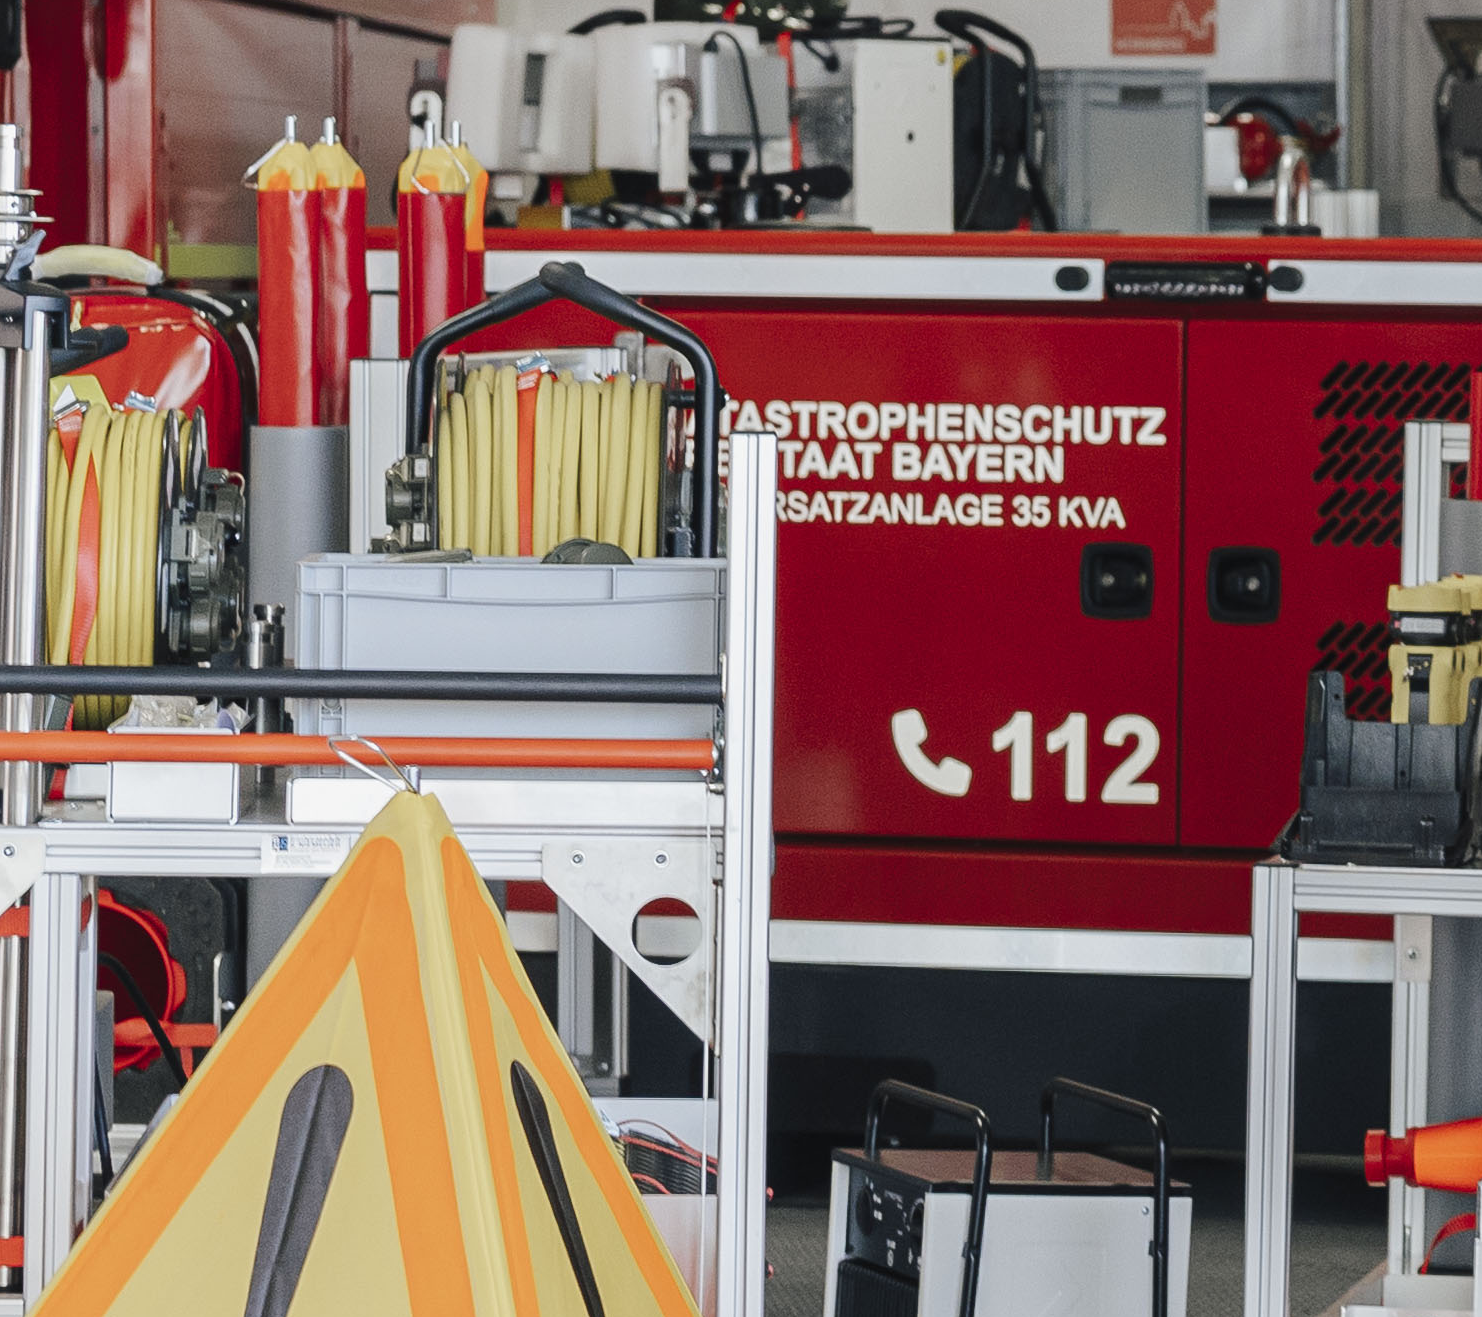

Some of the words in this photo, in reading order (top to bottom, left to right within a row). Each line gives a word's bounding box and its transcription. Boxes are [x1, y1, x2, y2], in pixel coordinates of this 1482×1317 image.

[686, 399, 1168, 446] TASTROPHENSCHUTZ
[891, 444, 1064, 483] BAYERN
[776, 490, 1004, 527] RSATZANLAGE
[1011, 495, 1051, 527] 35
[1057, 497, 1127, 530] KVA
[991, 712, 1160, 804] 112
